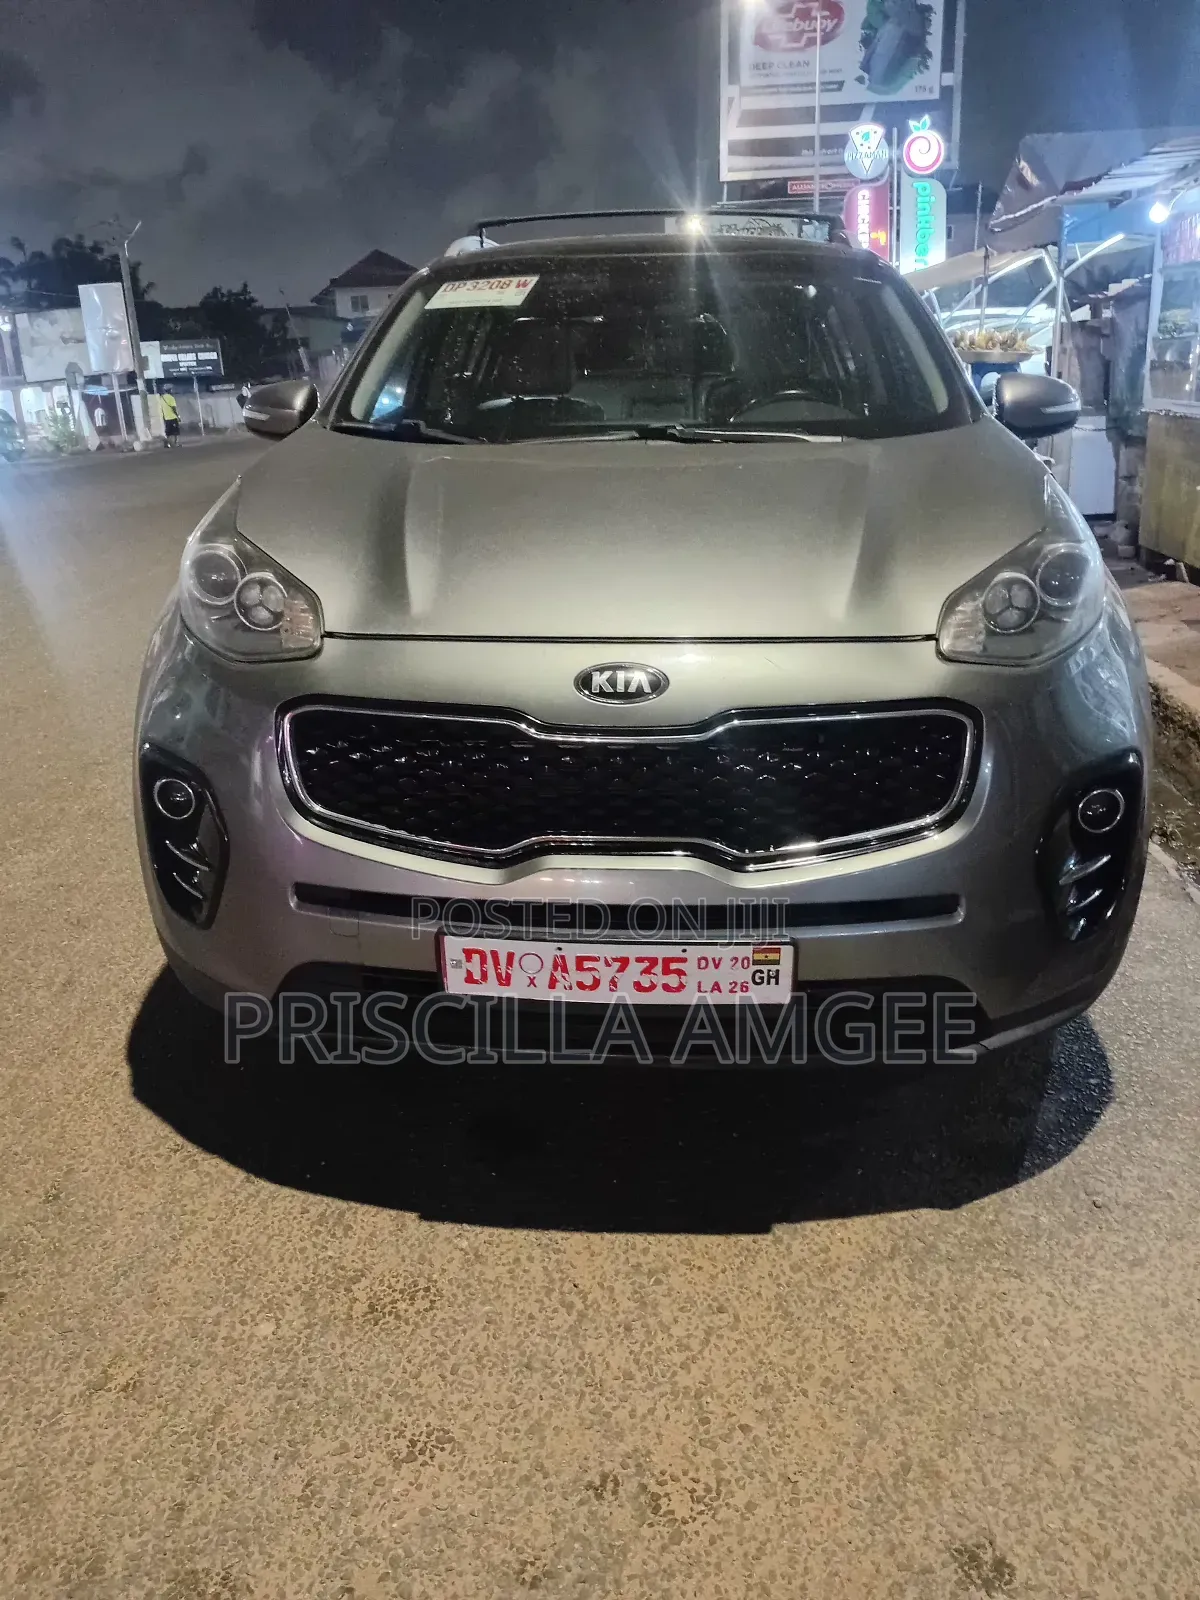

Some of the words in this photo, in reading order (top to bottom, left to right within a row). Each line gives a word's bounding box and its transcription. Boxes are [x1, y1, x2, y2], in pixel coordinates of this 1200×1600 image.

[777, 60, 810, 69] CLEAN
[466, 279, 513, 292] 3208
[514, 278, 533, 289] W
[591, 671, 652, 693] KIA
[462, 947, 515, 987] DV
[548, 953, 688, 993] A5735
[696, 956, 723, 971] DV
[730, 955, 750, 971] 20
[751, 968, 780, 986] GH
[696, 981, 722, 994] LA
[728, 980, 750, 994] 26
